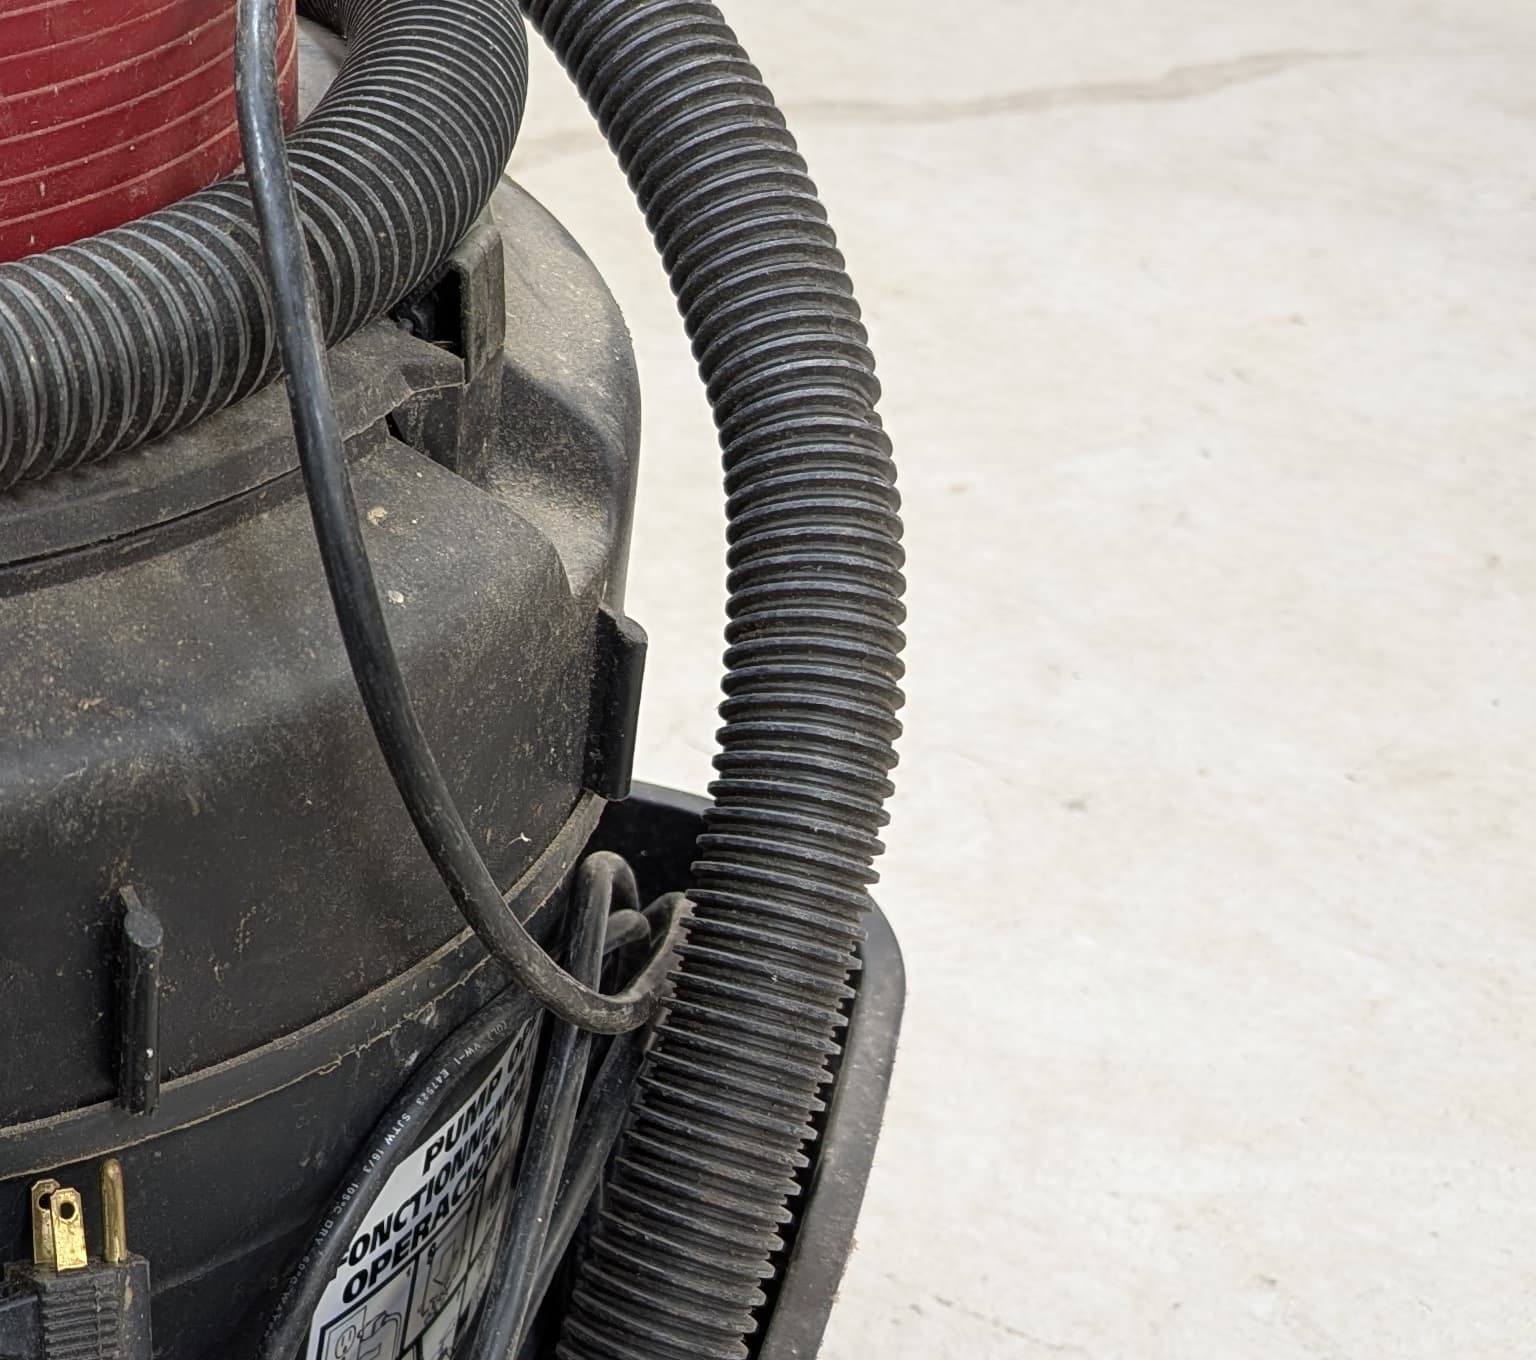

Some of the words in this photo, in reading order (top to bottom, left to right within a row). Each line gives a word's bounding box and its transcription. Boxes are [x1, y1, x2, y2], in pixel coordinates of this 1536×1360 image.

[383, 1111, 412, 1146] SJTW
[422, 1068, 503, 1177] PUMP
[362, 1148, 386, 1174] 16/3
[314, 1219, 335, 1247] DRY
